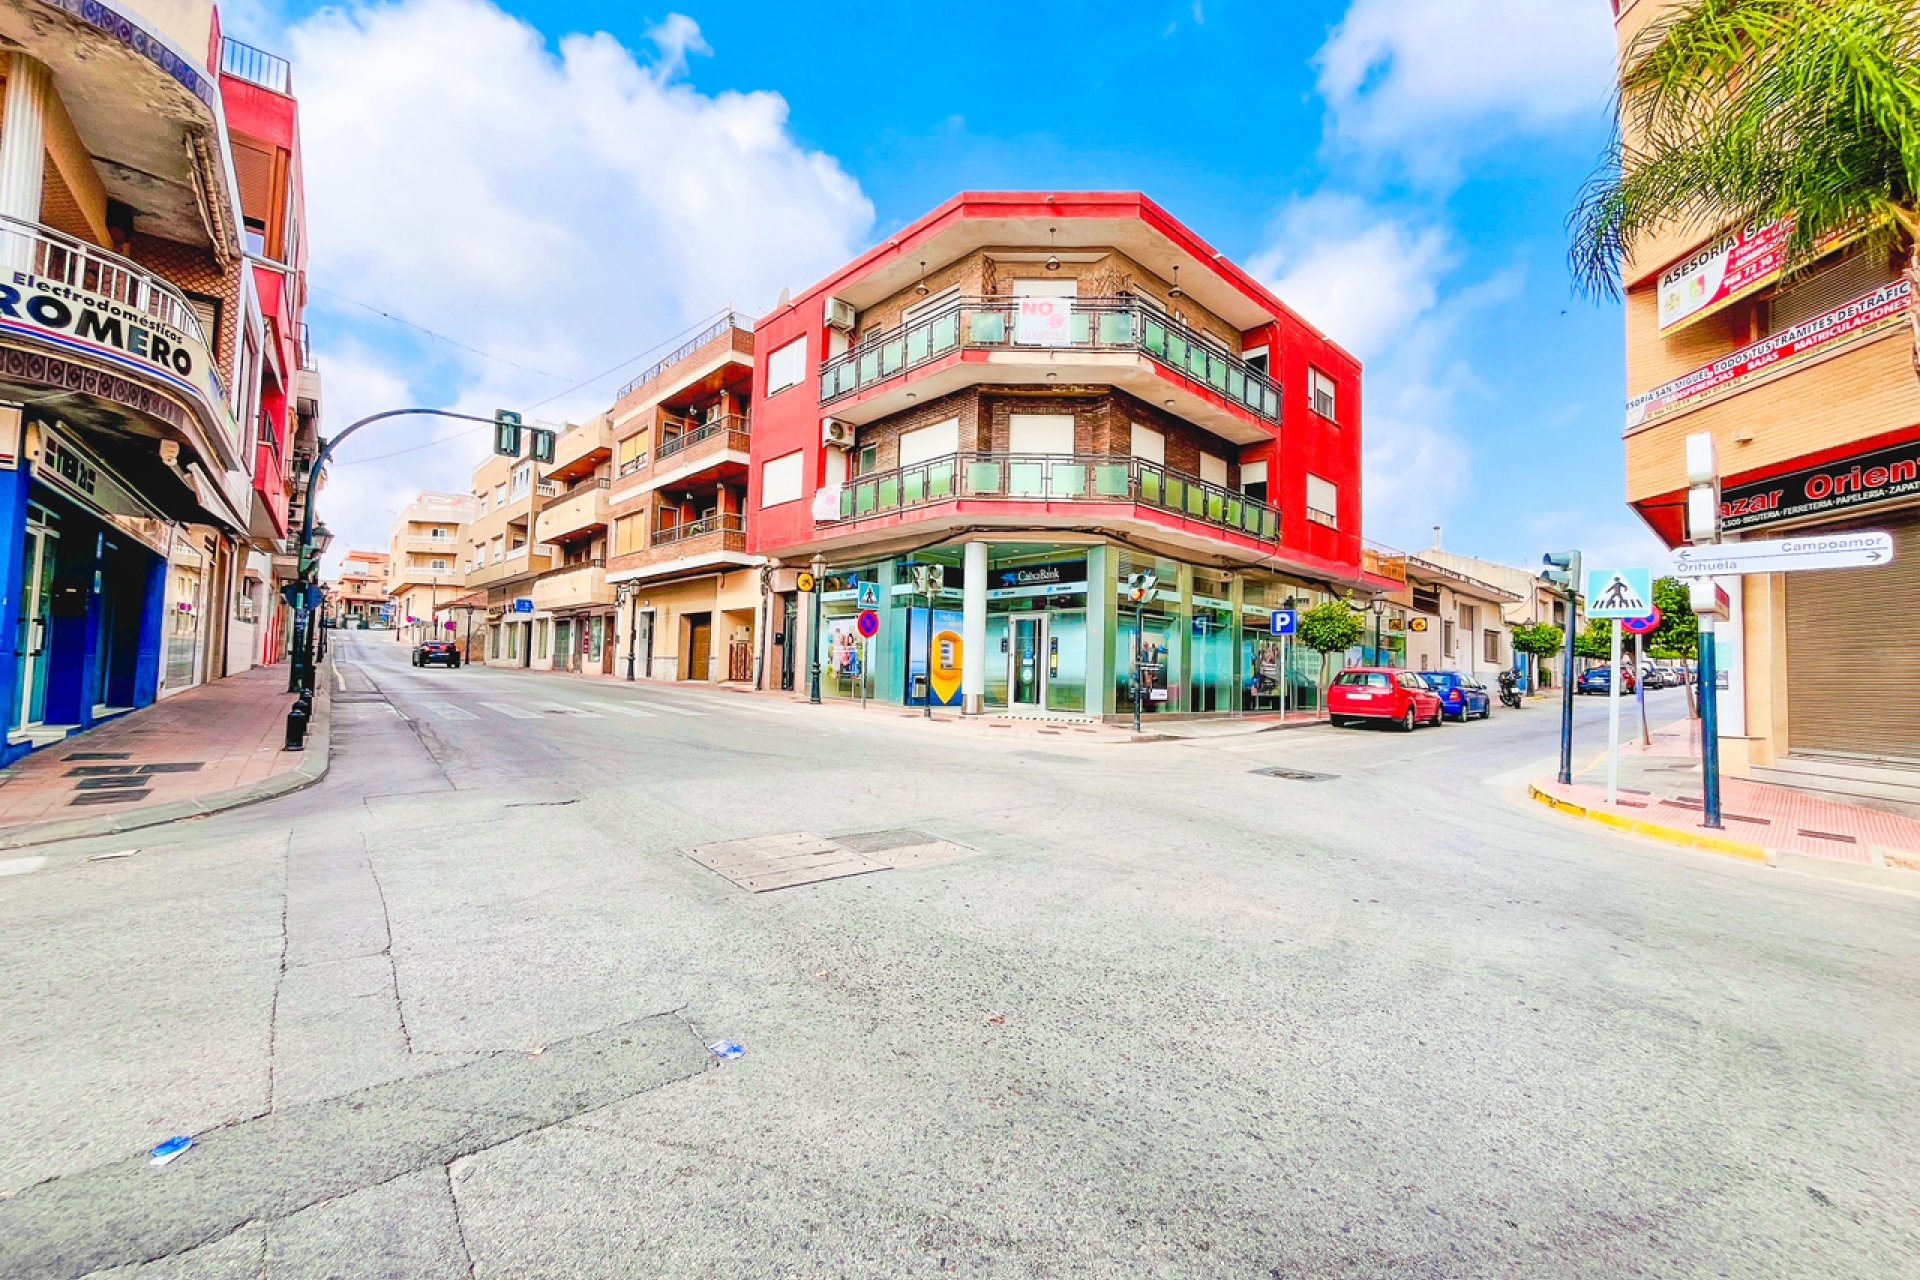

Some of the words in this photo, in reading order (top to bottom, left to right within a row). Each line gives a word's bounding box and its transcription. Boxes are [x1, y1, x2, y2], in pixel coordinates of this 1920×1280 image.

[1662, 235, 1738, 288] ASESORIA
[13, 271, 183, 344] Electrodomésticos
[1022, 301, 1054, 315] NO
[0, 283, 193, 377] ROMERO
[1655, 385, 1672, 398] SAN
[1714, 352, 1749, 372] TODOS
[1752, 342, 1771, 356] TUS
[1837, 306, 1855, 322] DE
[1859, 282, 1909, 310] TRAFIC
[1746, 351, 1779, 371] BAJAS
[1720, 489, 1784, 518] azar
[1804, 457, 1920, 499] Orien
[1783, 499, 1833, 516] FERRETERIA
[1836, 488, 1885, 504] PAPELERIA
[1889, 480, 1920, 494] ZAPAT
[1781, 537, 1883, 553] Campoamor
[1677, 560, 1738, 572] Orihuela
[1275, 612, 1291, 632] P
